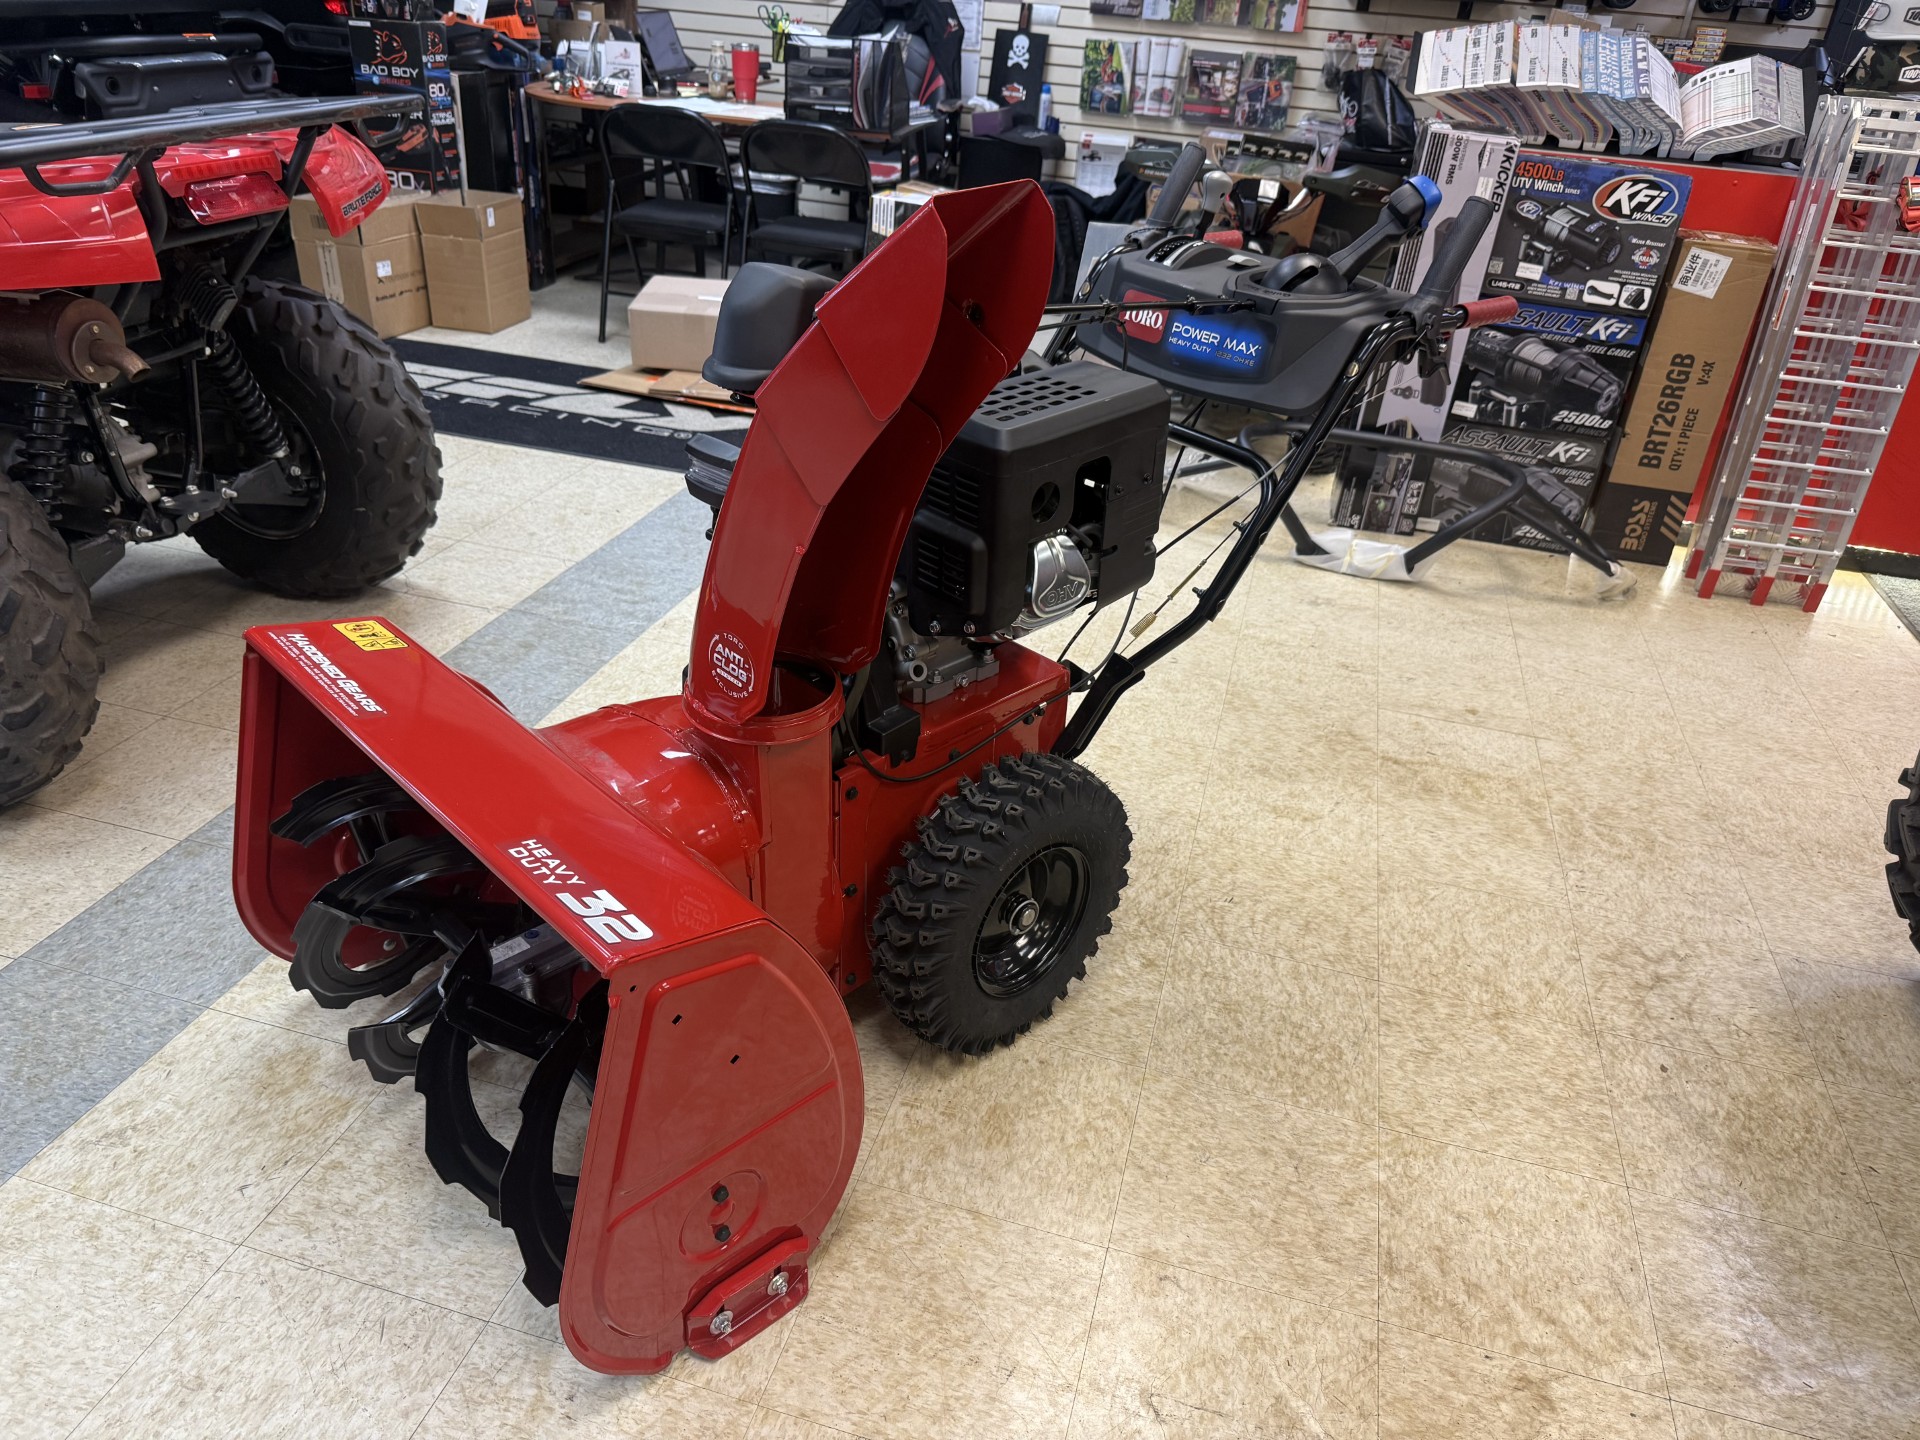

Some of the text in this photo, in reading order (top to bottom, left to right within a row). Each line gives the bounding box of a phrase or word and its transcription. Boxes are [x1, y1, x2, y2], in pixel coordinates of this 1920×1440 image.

[422, 54, 448, 62] BAD BOY
[1621, 38, 1634, 78] APPAREL
[360, 64, 419, 78] BAD BOY
[1445, 135, 1464, 185] 300W RMS
[1515, 162, 1565, 182] 4500LB
[1512, 176, 1533, 189] UTV
[1534, 179, 1564, 194] Winch
[342, 182, 382, 217] BRUTE FORCE
[1632, 211, 1672, 224] WINCH
[1680, 252, 1702, 286] 商业件
[1124, 308, 1162, 329] TORO
[1509, 308, 1591, 334] SAULT
[1168, 336, 1212, 354] HEAVY DUTY
[1172, 322, 1260, 357] POWER MAX
[1540, 334, 1577, 343] SERIES
[1215, 350, 1255, 367] 1232 OHXE
[1583, 345, 1636, 358] STEEL CABLE
[1696, 360, 1716, 386] V:4X
[1552, 410, 1613, 429] 2500LB
[1638, 353, 1696, 469] BRT26RGB
[1440, 424, 1550, 458] ASSAULT
[1556, 425, 1608, 438] ATV WINCH
[1669, 447, 1686, 472] QTY:
[1681, 407, 1699, 439] PIECE
[1502, 455, 1538, 465] SERIES
[1550, 466, 1595, 479] SYNTHETIC
[1564, 477, 1592, 487] CABLE
[1620, 500, 1650, 551] BOSS
[1638, 502, 1658, 551] AUDIO SYSTEMS
[1046, 581, 1078, 606] OHV
[724, 632, 744, 650] TORO
[713, 653, 747, 683] CLOG
[716, 643, 749, 668] ANTI-
[286, 634, 383, 712] HARDENED GEARS
[712, 670, 749, 699] EXCLUSIVE
[508, 847, 563, 884] DUTY
[521, 839, 586, 885] HEAVY
[555, 889, 654, 944] 32
